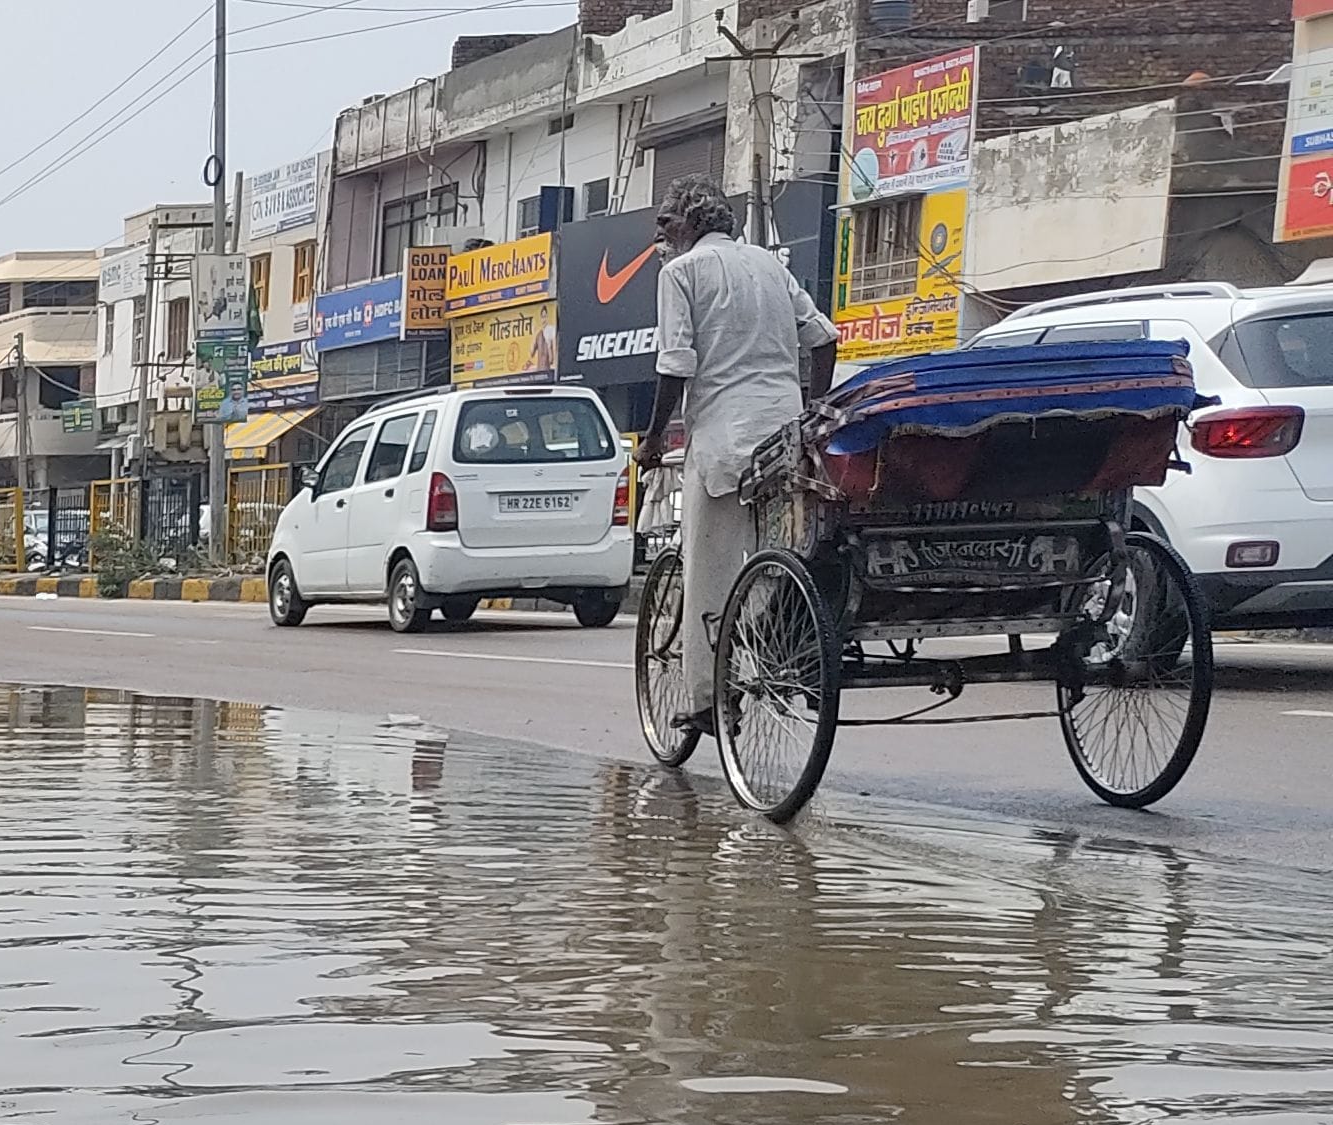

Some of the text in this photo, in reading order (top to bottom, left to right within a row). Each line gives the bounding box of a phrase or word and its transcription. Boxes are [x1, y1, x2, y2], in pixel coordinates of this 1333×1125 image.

[877, 85, 901, 148] दुर्गा
[411, 253, 447, 267] GOLD
[411, 268, 447, 281] LOAN
[410, 285, 444, 301] गोल्ड
[411, 304, 444, 320] लोन
[512, 311, 533, 338] लोन
[506, 496, 520, 510] HR
